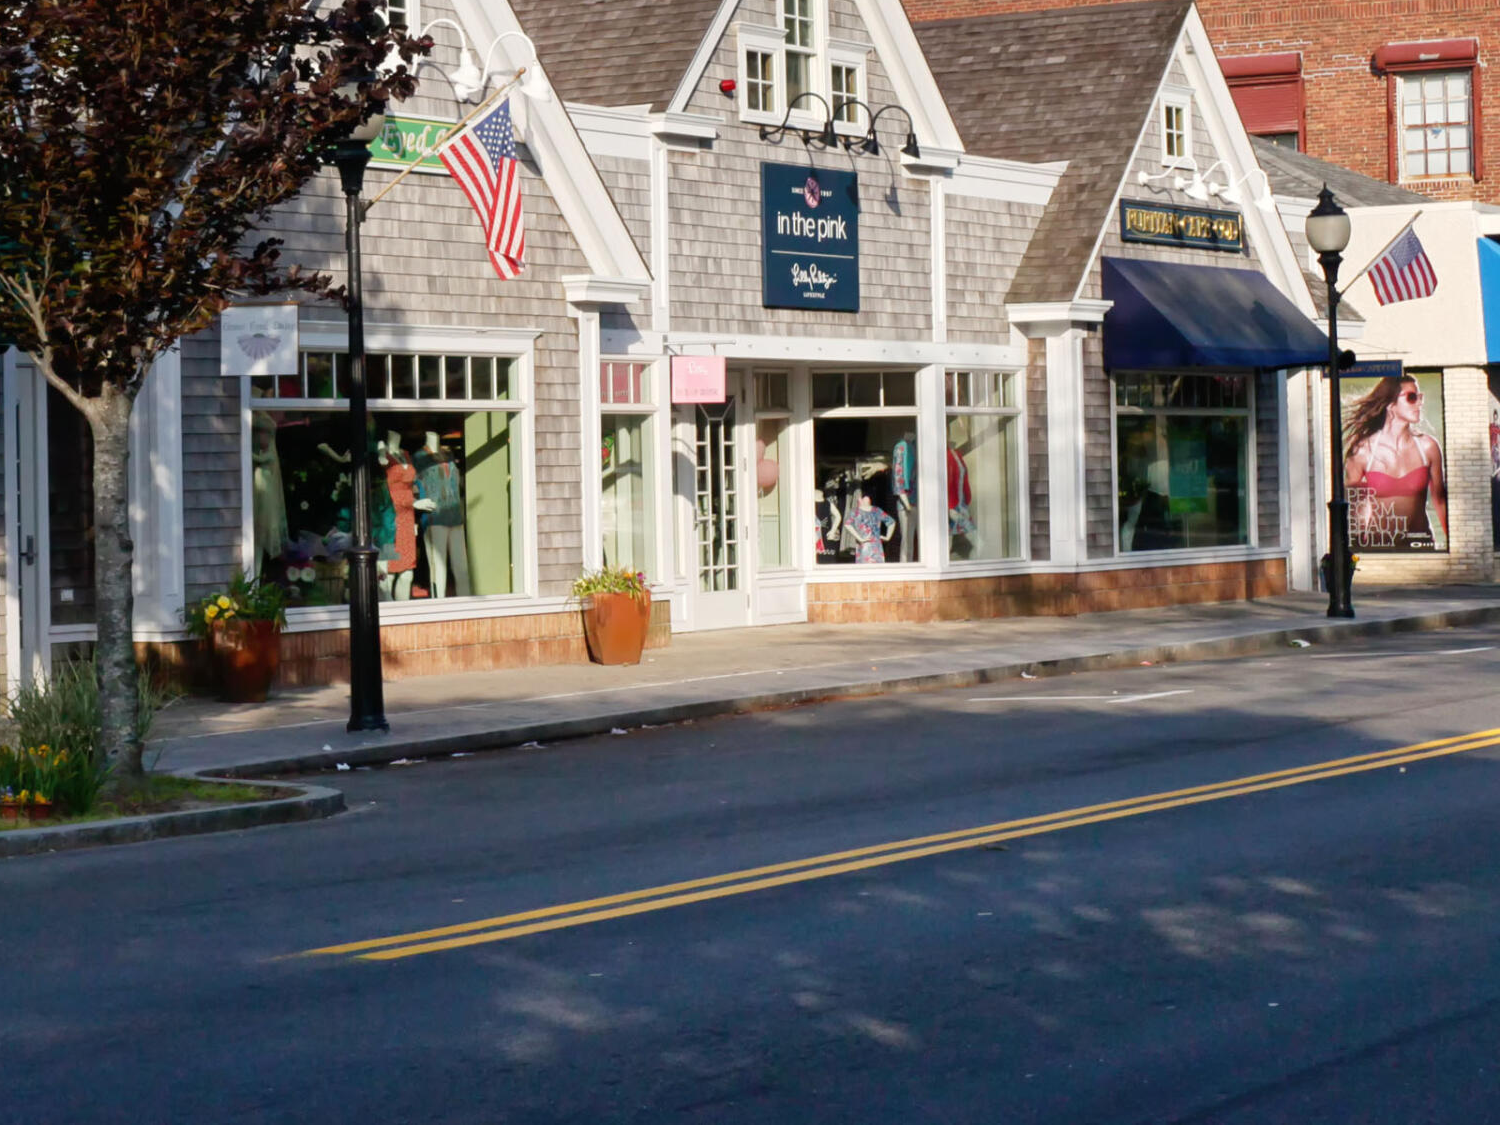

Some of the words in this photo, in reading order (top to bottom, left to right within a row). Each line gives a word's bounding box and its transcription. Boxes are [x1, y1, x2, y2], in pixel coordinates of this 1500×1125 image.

[777, 211, 790, 235] in
[792, 211, 815, 238] the
[818, 214, 848, 242] pink
[1346, 487, 1377, 504] PER
[1347, 501, 1396, 517] FORM
[1348, 516, 1408, 532] BEAUTI
